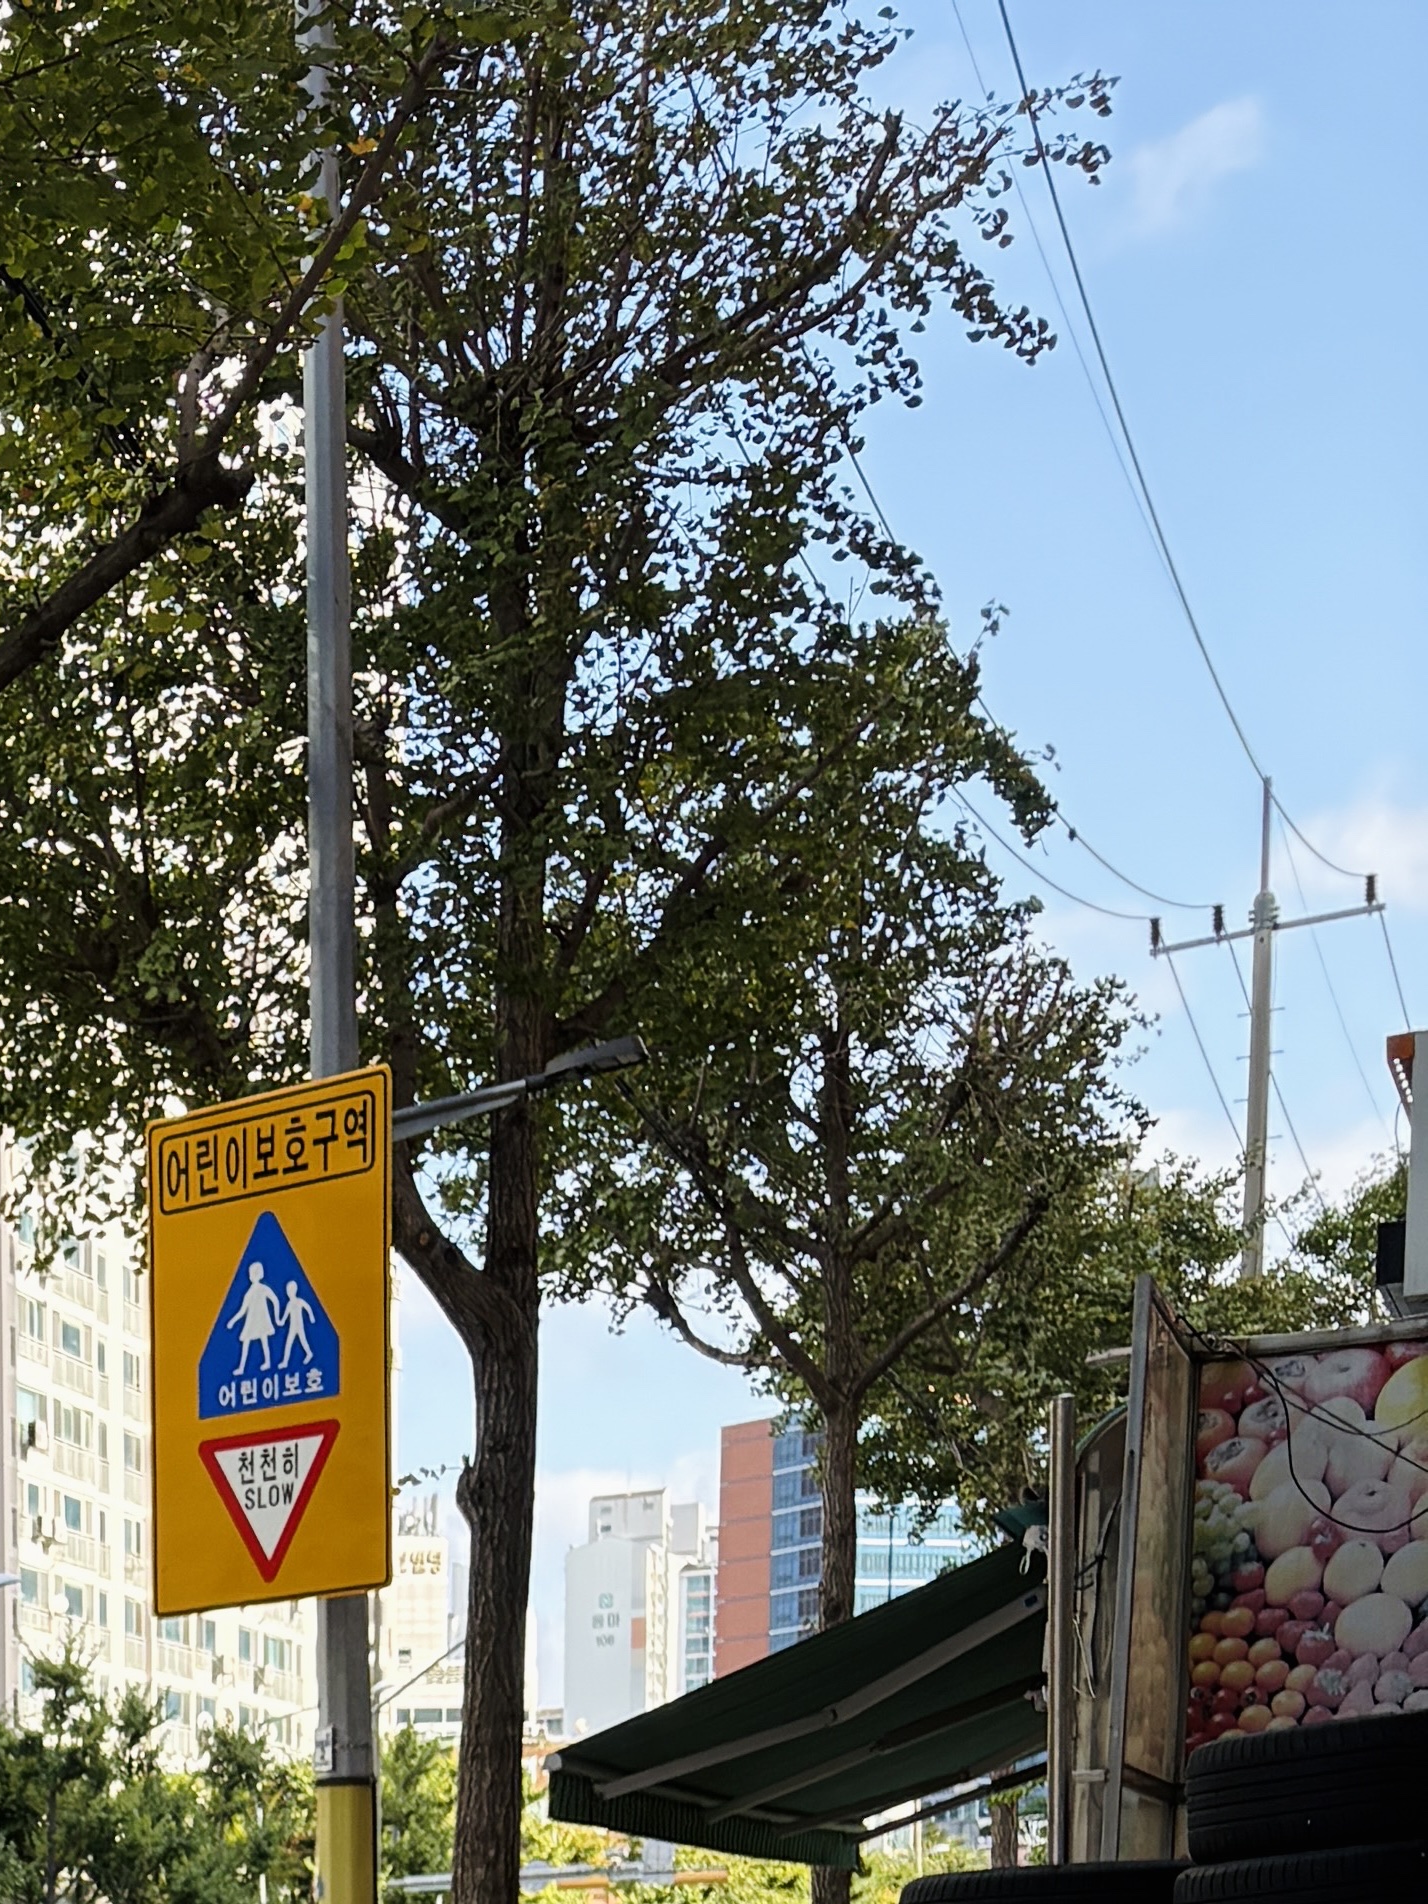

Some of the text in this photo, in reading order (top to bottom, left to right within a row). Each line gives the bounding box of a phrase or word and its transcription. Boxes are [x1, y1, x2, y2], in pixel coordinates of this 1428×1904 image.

[165, 1098, 369, 1203] 어린이보호구역
[218, 1366, 324, 1410] 어린이보호
[237, 1440, 300, 1485] 천천히
[244, 1479, 295, 1510] SLOW
